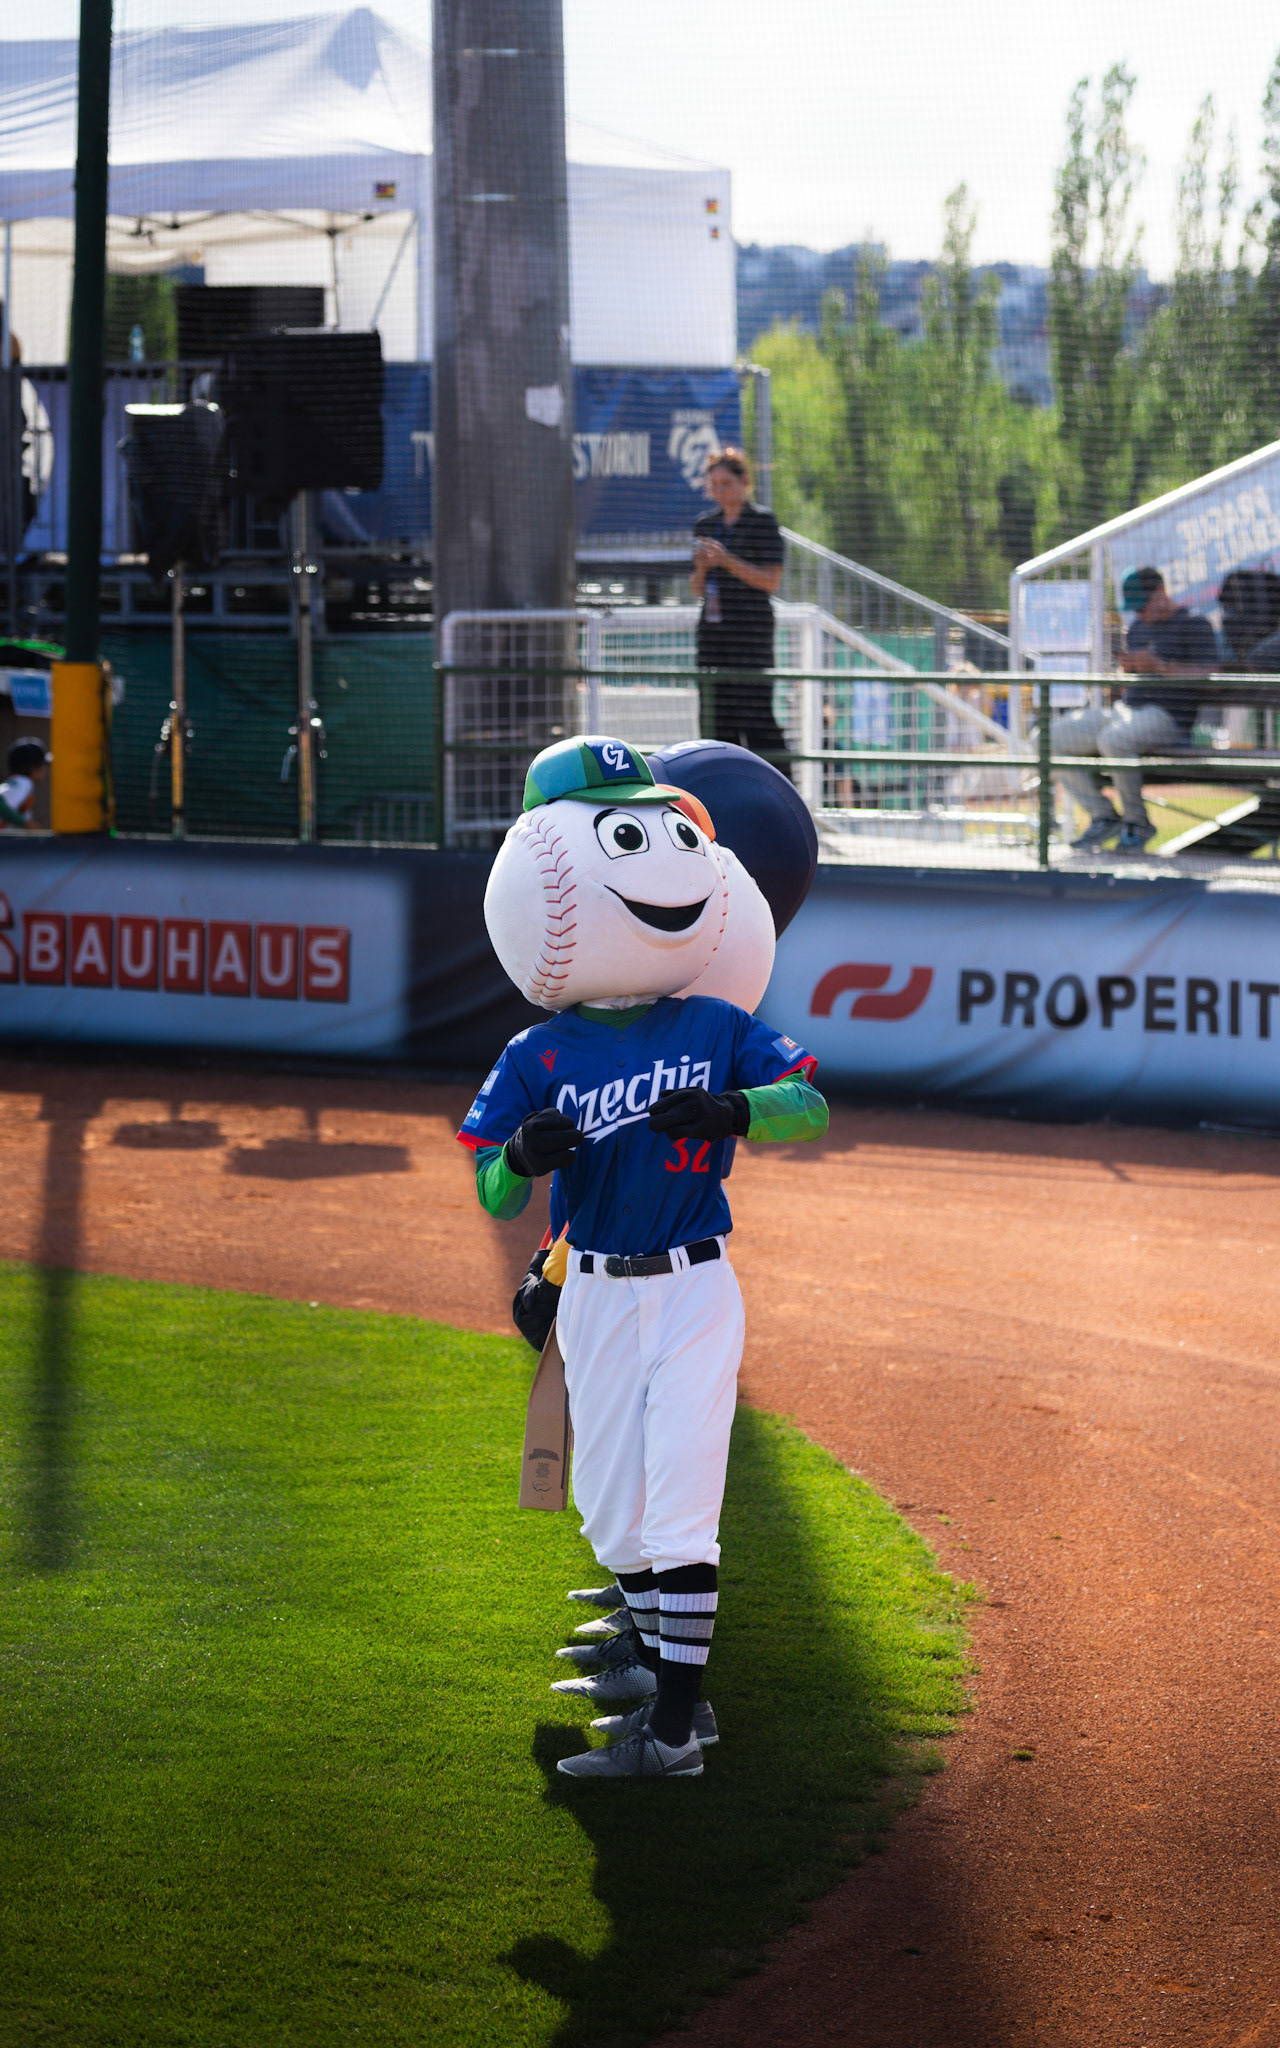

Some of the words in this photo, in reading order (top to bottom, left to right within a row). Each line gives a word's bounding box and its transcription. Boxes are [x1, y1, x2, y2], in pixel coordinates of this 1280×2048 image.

[602, 743, 630, 772] CZ
[29, 920, 343, 988] BAUHAUS
[958, 968, 1280, 1039] PROPERIT
